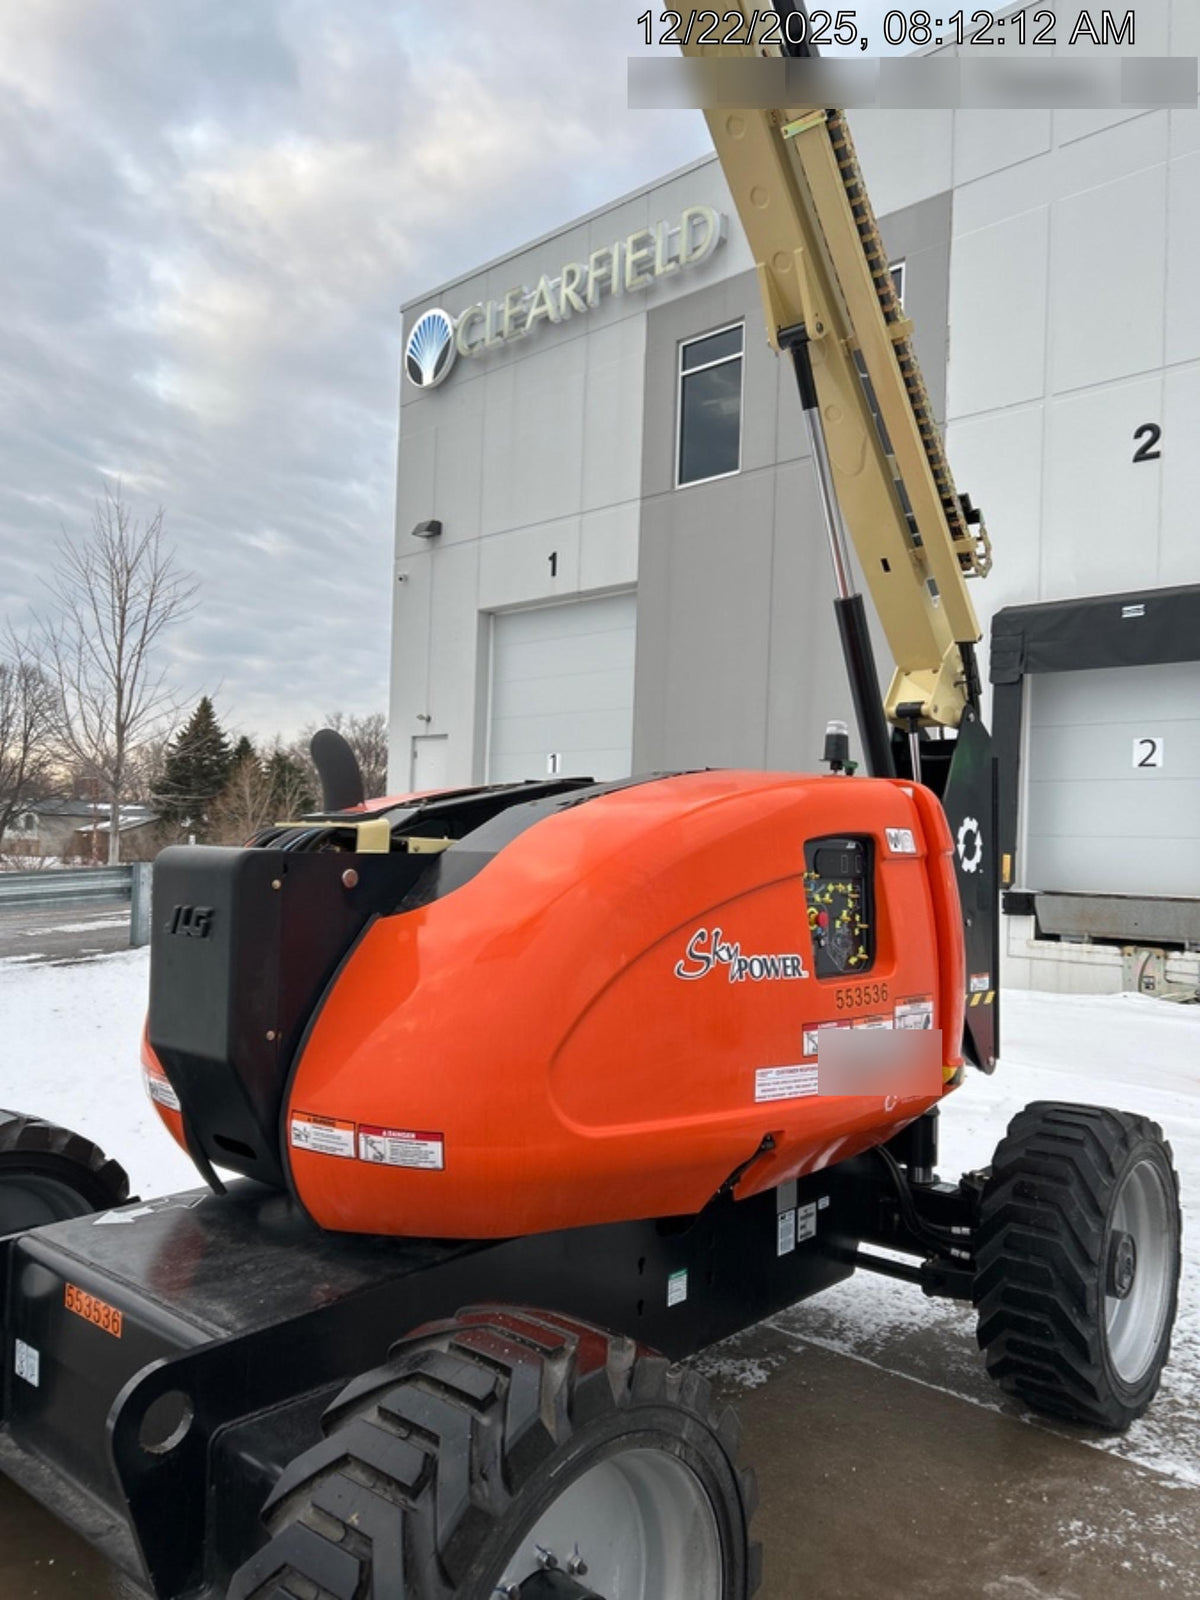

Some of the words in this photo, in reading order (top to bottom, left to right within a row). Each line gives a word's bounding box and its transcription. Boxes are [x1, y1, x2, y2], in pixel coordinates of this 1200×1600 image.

[455, 205, 727, 358] CLEARFIELD
[1132, 422, 1162, 463] 2
[548, 551, 557, 577] 1
[550, 753, 557, 773] 1
[1138, 738, 1157, 767] 2
[163, 904, 215, 938] JLG
[836, 982, 889, 1010] 553536
[65, 1284, 121, 1335] 553536
